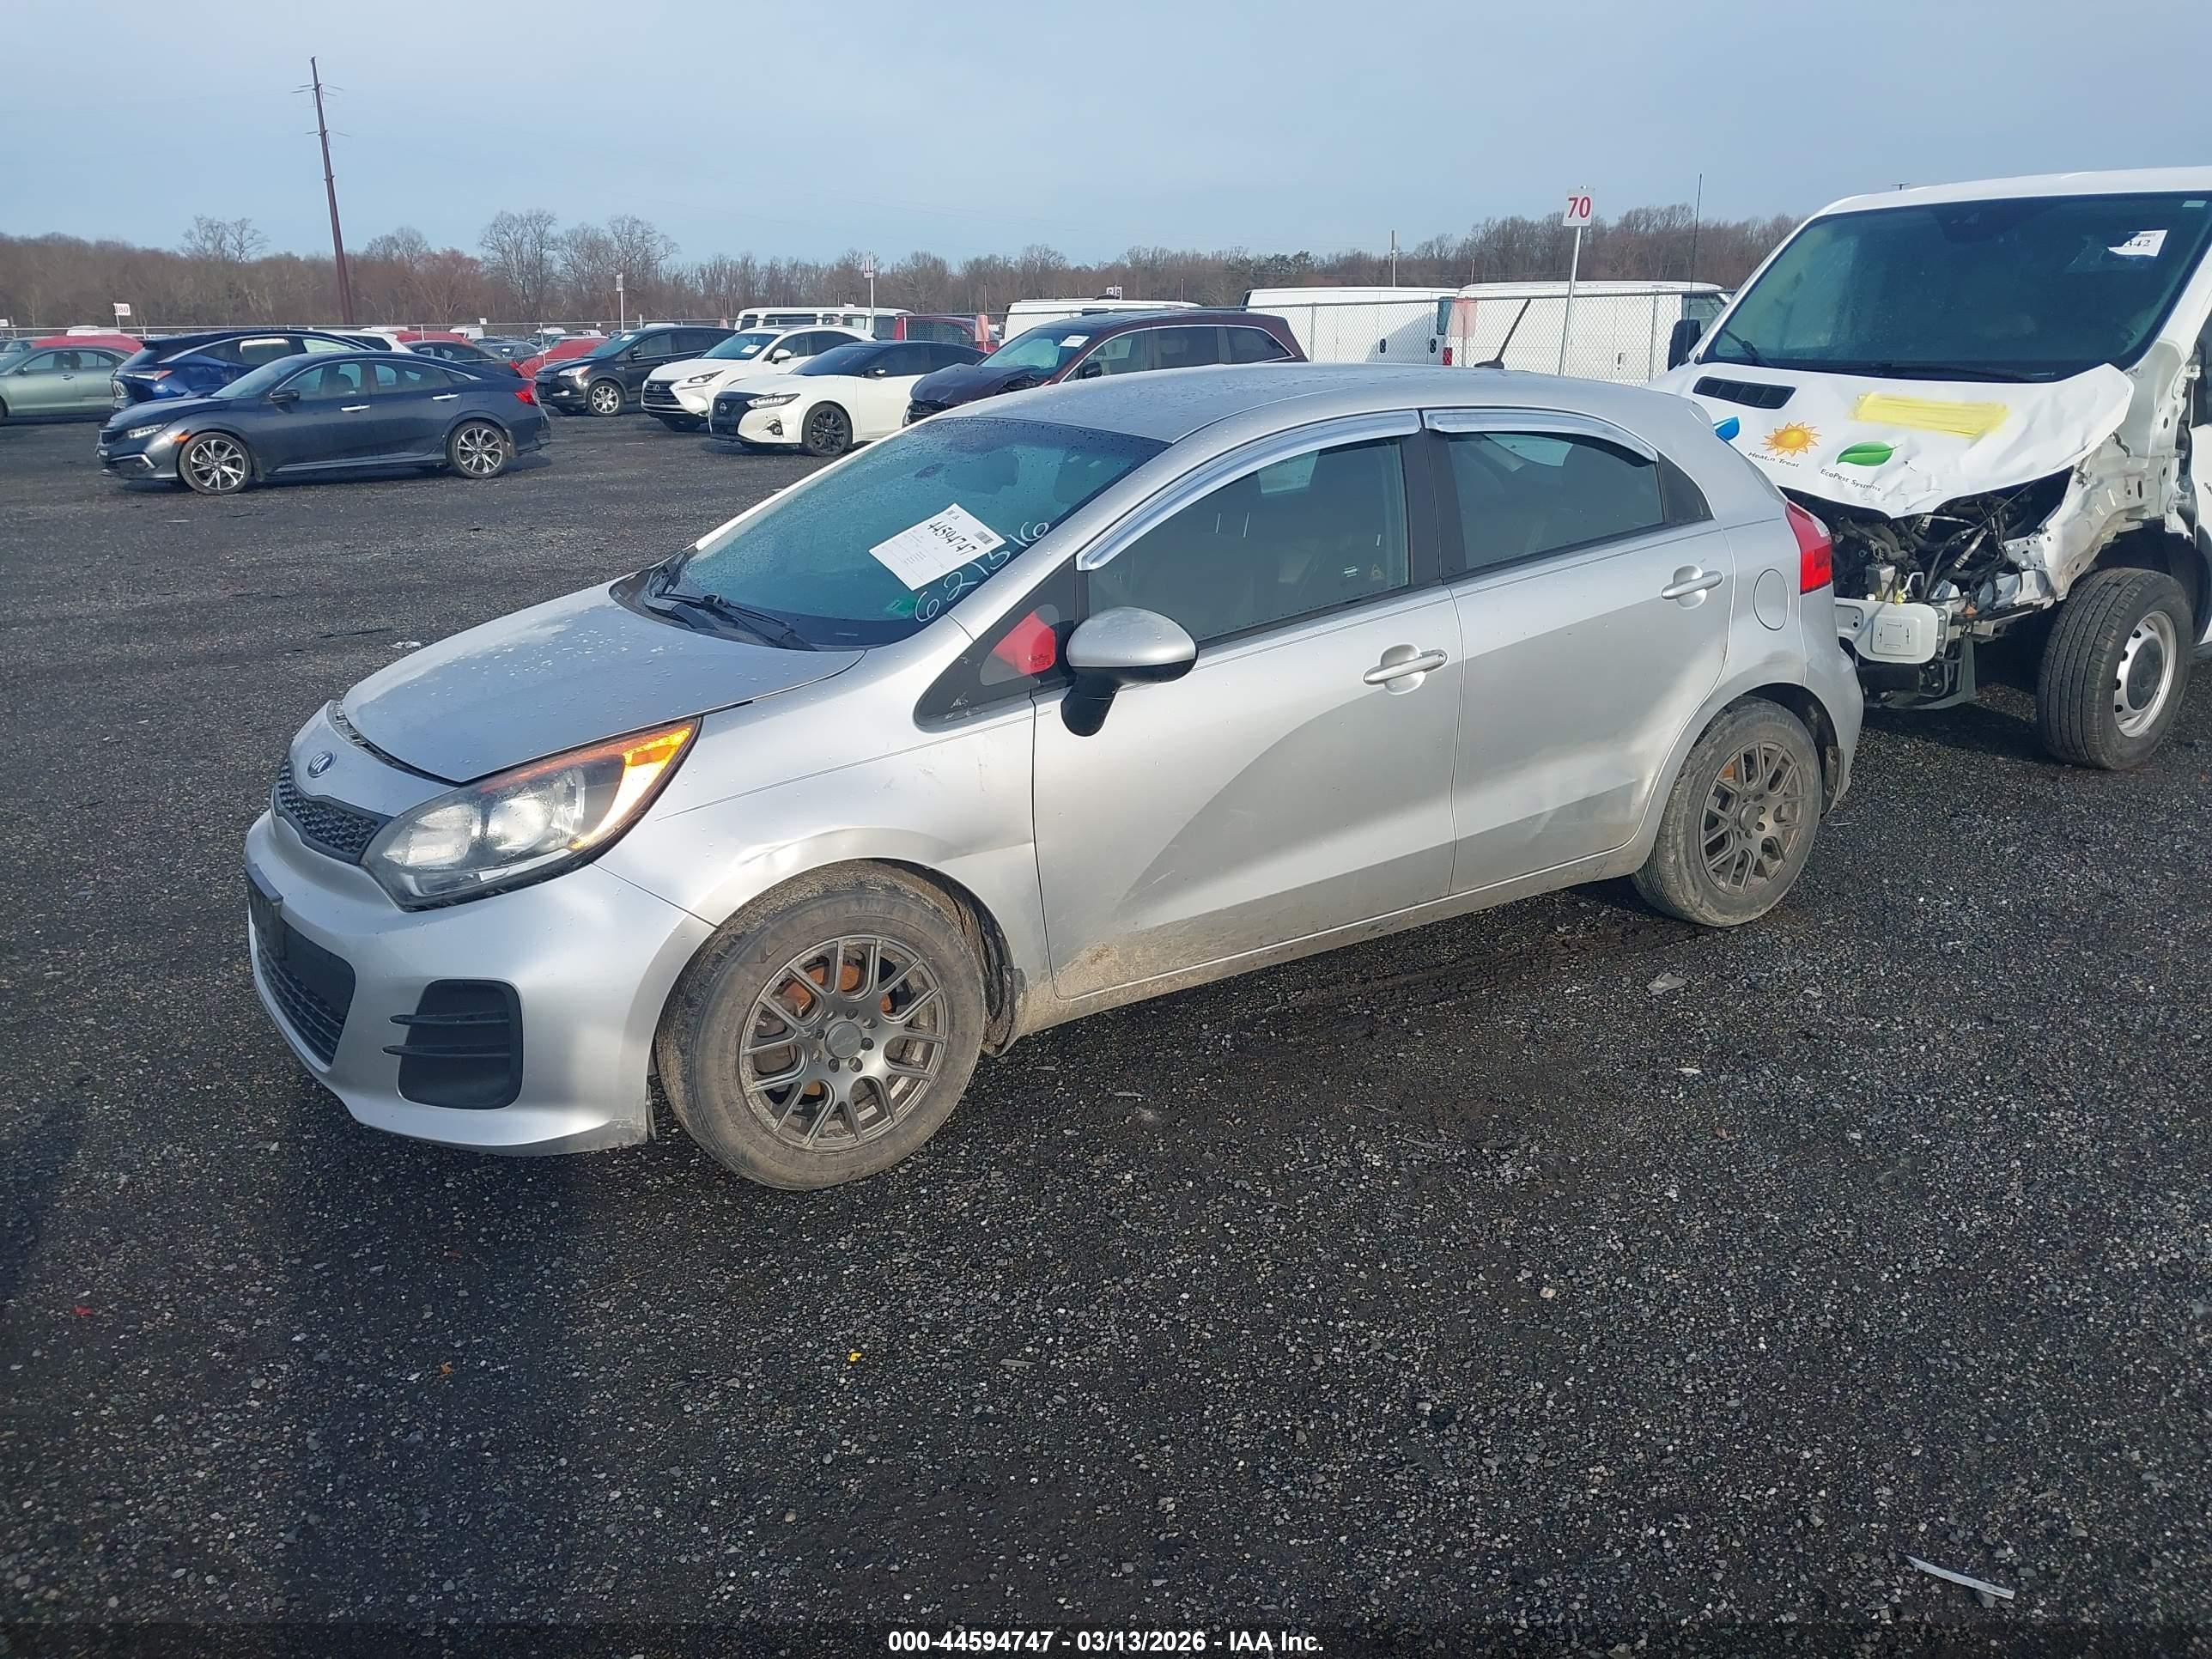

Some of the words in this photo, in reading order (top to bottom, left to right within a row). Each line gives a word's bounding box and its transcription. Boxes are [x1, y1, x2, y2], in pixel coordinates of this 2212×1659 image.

[1568, 197, 1591, 218] 70
[1779, 458, 1800, 468] Treat
[1820, 468, 1850, 483] EcoPest
[927, 521, 977, 556] 44594747
